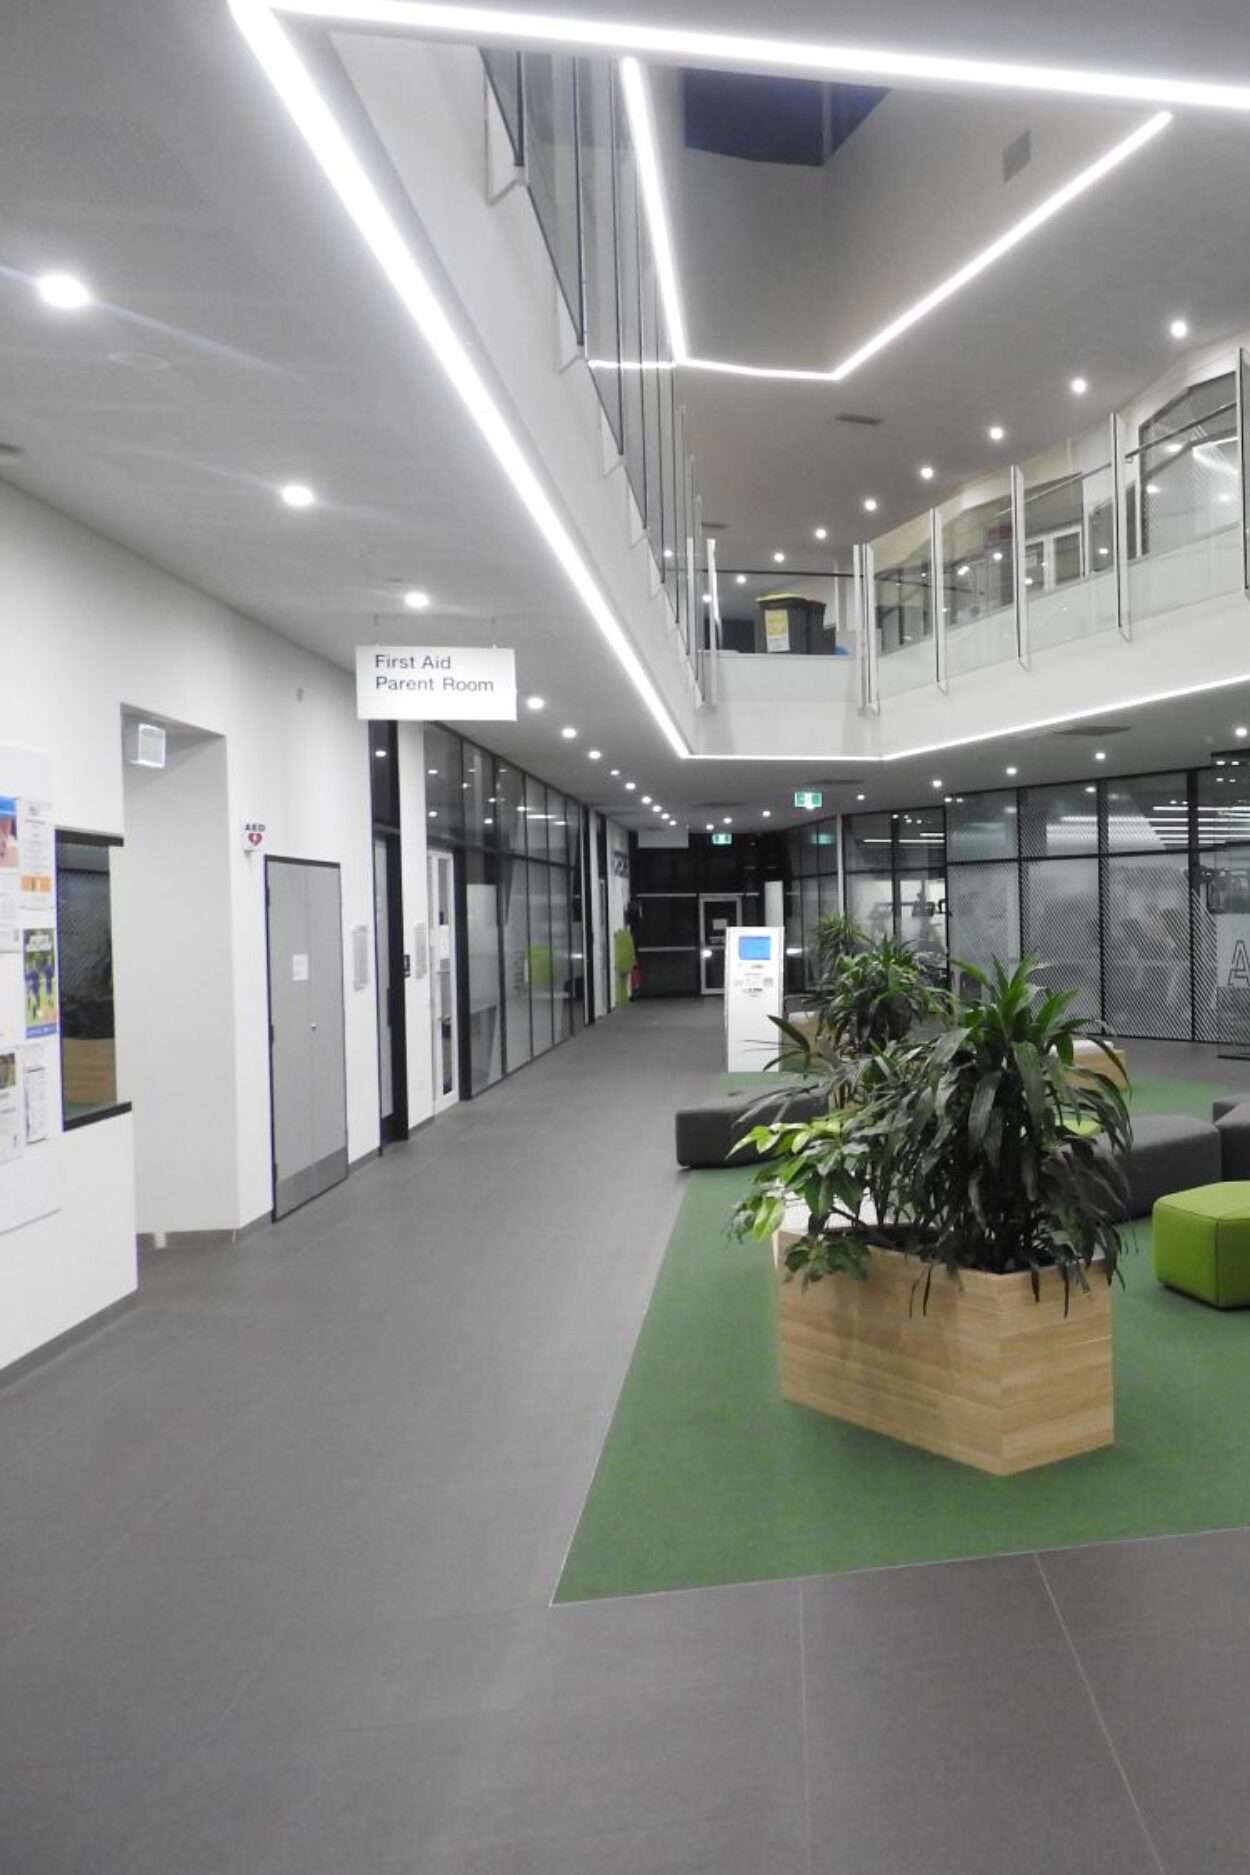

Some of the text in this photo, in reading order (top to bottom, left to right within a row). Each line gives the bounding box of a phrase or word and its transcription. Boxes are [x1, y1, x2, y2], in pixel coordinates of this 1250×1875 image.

[375, 654, 451, 670] First Aid
[376, 676, 494, 692] Parent Room
